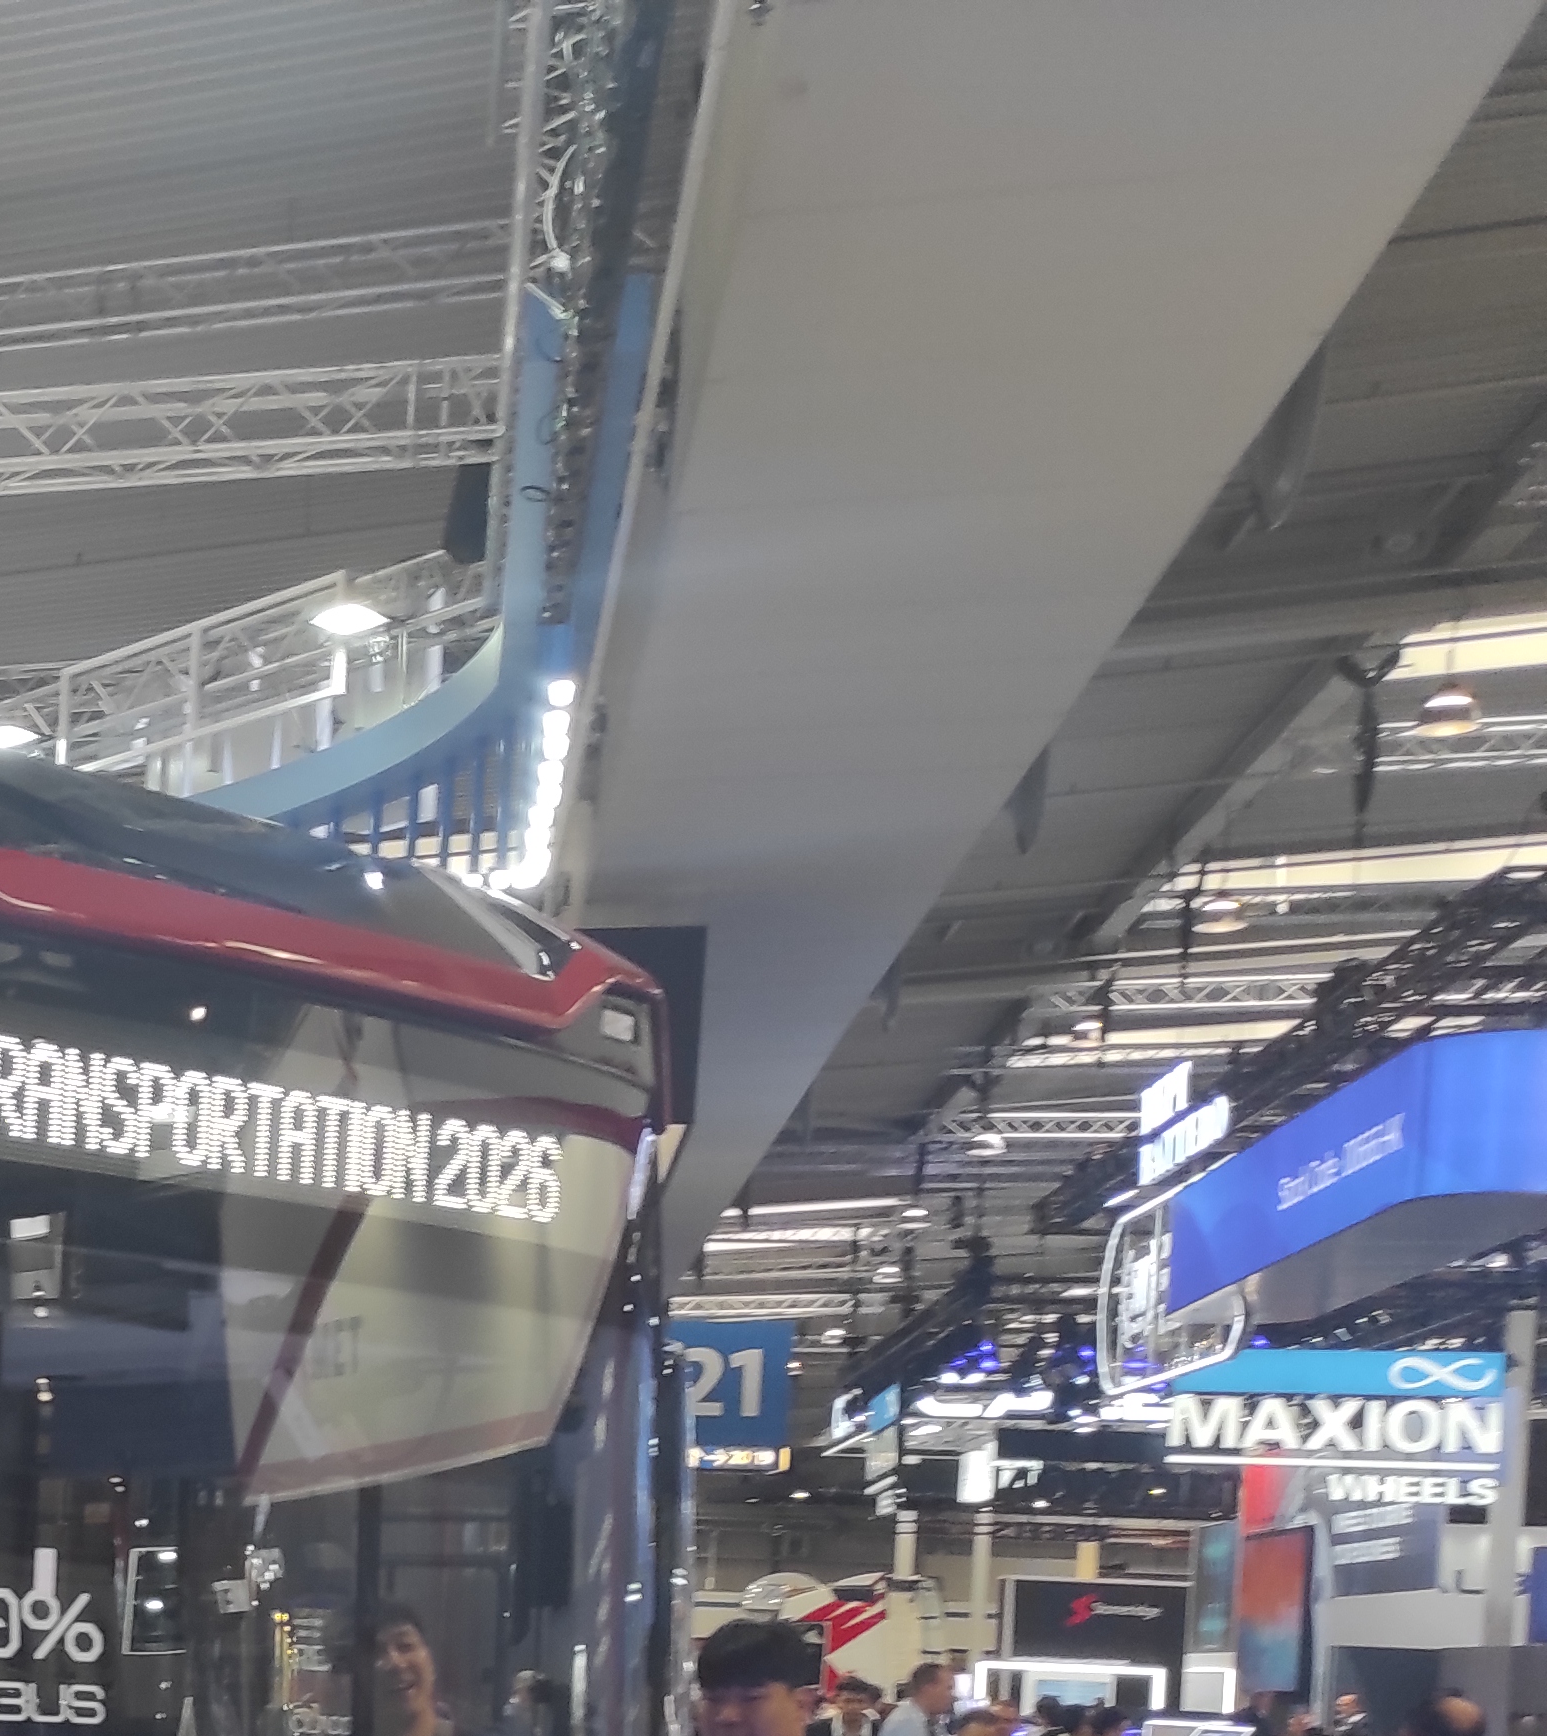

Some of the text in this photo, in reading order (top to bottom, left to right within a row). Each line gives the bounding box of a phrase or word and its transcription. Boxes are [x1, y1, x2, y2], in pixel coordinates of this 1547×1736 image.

[433, 1118, 564, 1223] 2026
[683, 1347, 764, 1417] 21
[1165, 1395, 1504, 1454] MAXION
[1325, 1473, 1501, 1506] WHEELS
